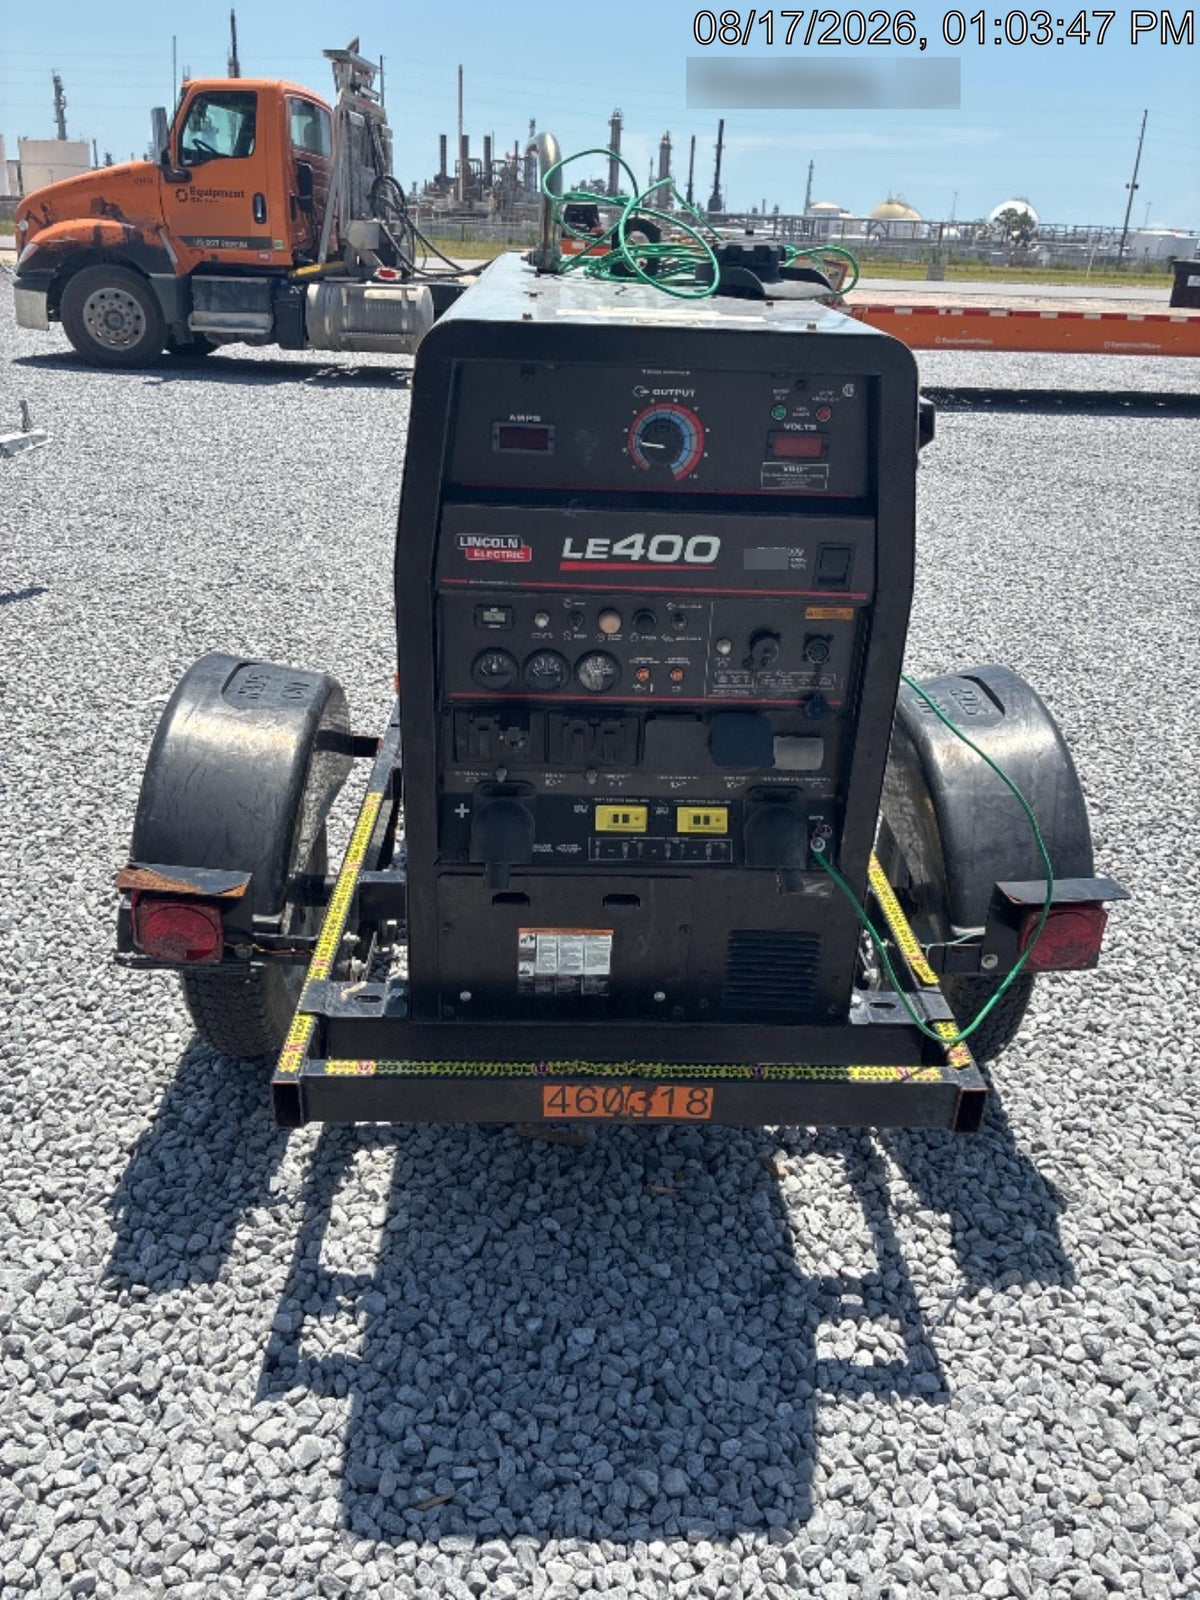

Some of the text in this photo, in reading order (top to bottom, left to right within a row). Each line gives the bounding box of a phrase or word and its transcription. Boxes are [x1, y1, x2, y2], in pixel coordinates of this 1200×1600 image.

[189, 186, 245, 199] Equipment
[652, 388, 696, 397] OUTPUT
[509, 414, 541, 422] AMPS
[783, 422, 817, 431] VOLTS
[459, 535, 519, 549] LINCOLN
[561, 533, 721, 563] LE400
[473, 549, 525, 560] ELECTRIC
[402, 1063, 434, 1072] NOT
